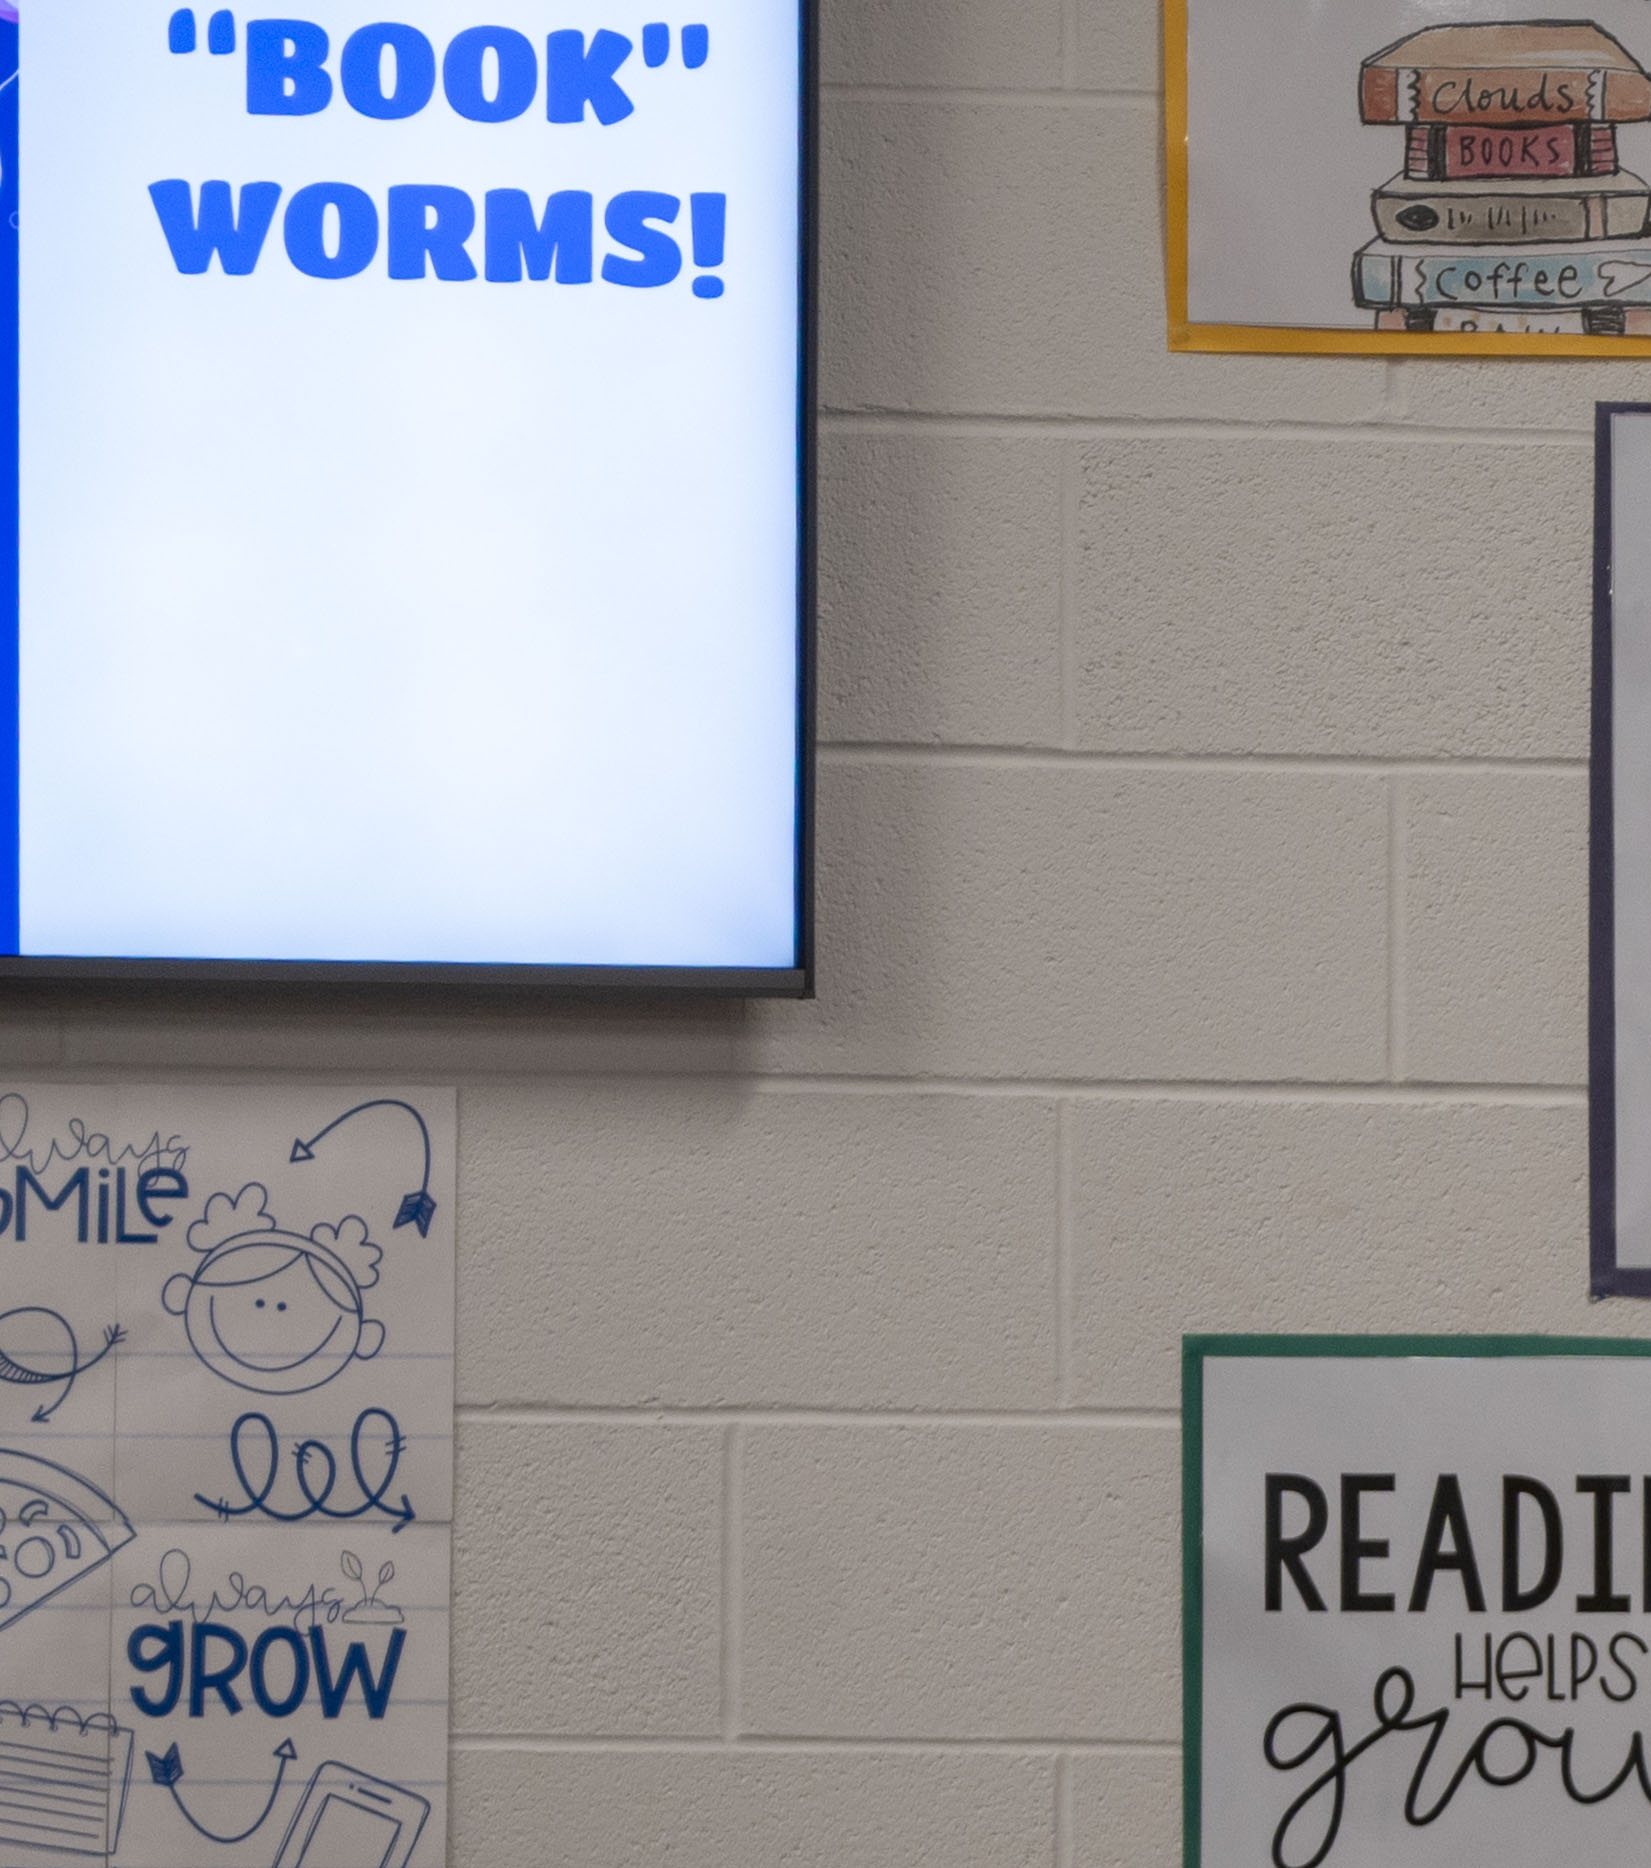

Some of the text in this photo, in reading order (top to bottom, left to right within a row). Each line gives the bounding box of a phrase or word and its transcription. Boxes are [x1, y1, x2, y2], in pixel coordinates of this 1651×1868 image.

[1433, 69, 1575, 116] Clouds
[1458, 134, 1562, 168] BOOKS
[148, 179, 727, 299] WORMS!
[0, 1093, 190, 1187] lways
